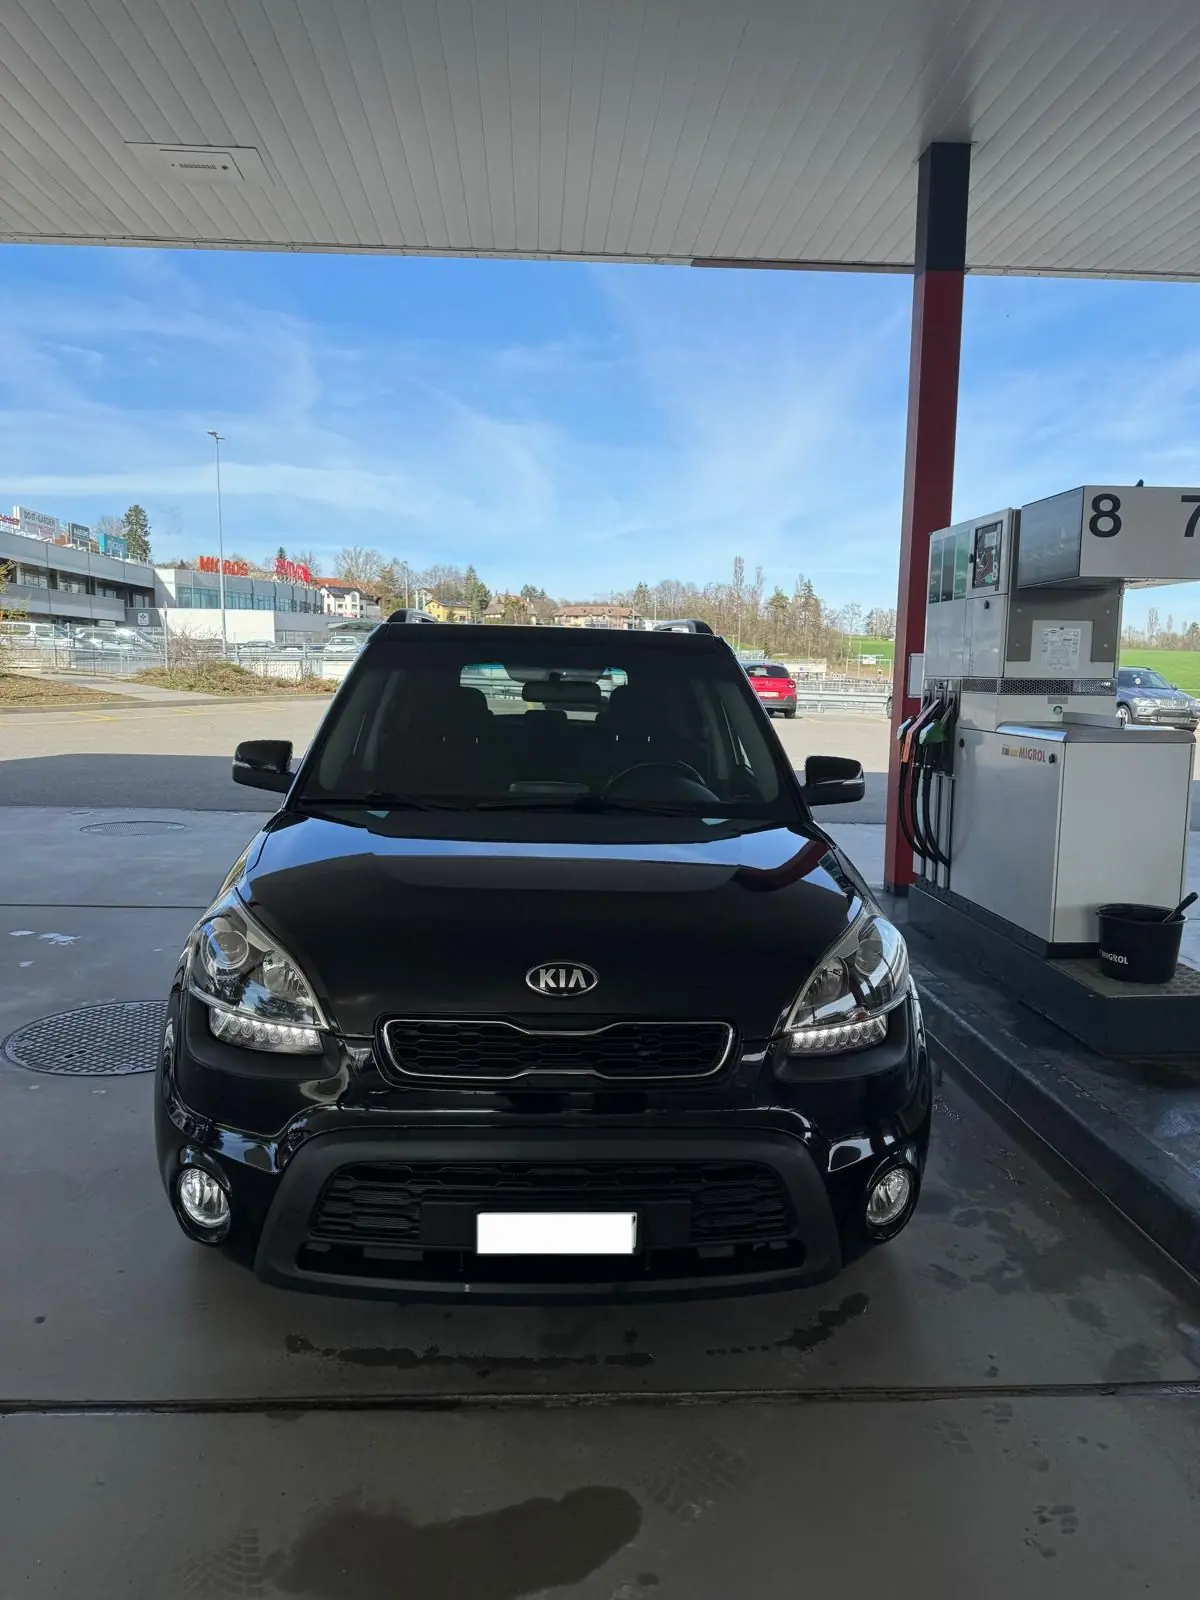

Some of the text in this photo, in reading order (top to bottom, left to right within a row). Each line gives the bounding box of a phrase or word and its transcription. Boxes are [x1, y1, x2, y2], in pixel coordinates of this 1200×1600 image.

[1089, 493, 1200, 538] 8 7
[198, 555, 249, 576] MIGROS
[1018, 746, 1046, 763] MIGROL
[539, 968, 587, 988] KIA
